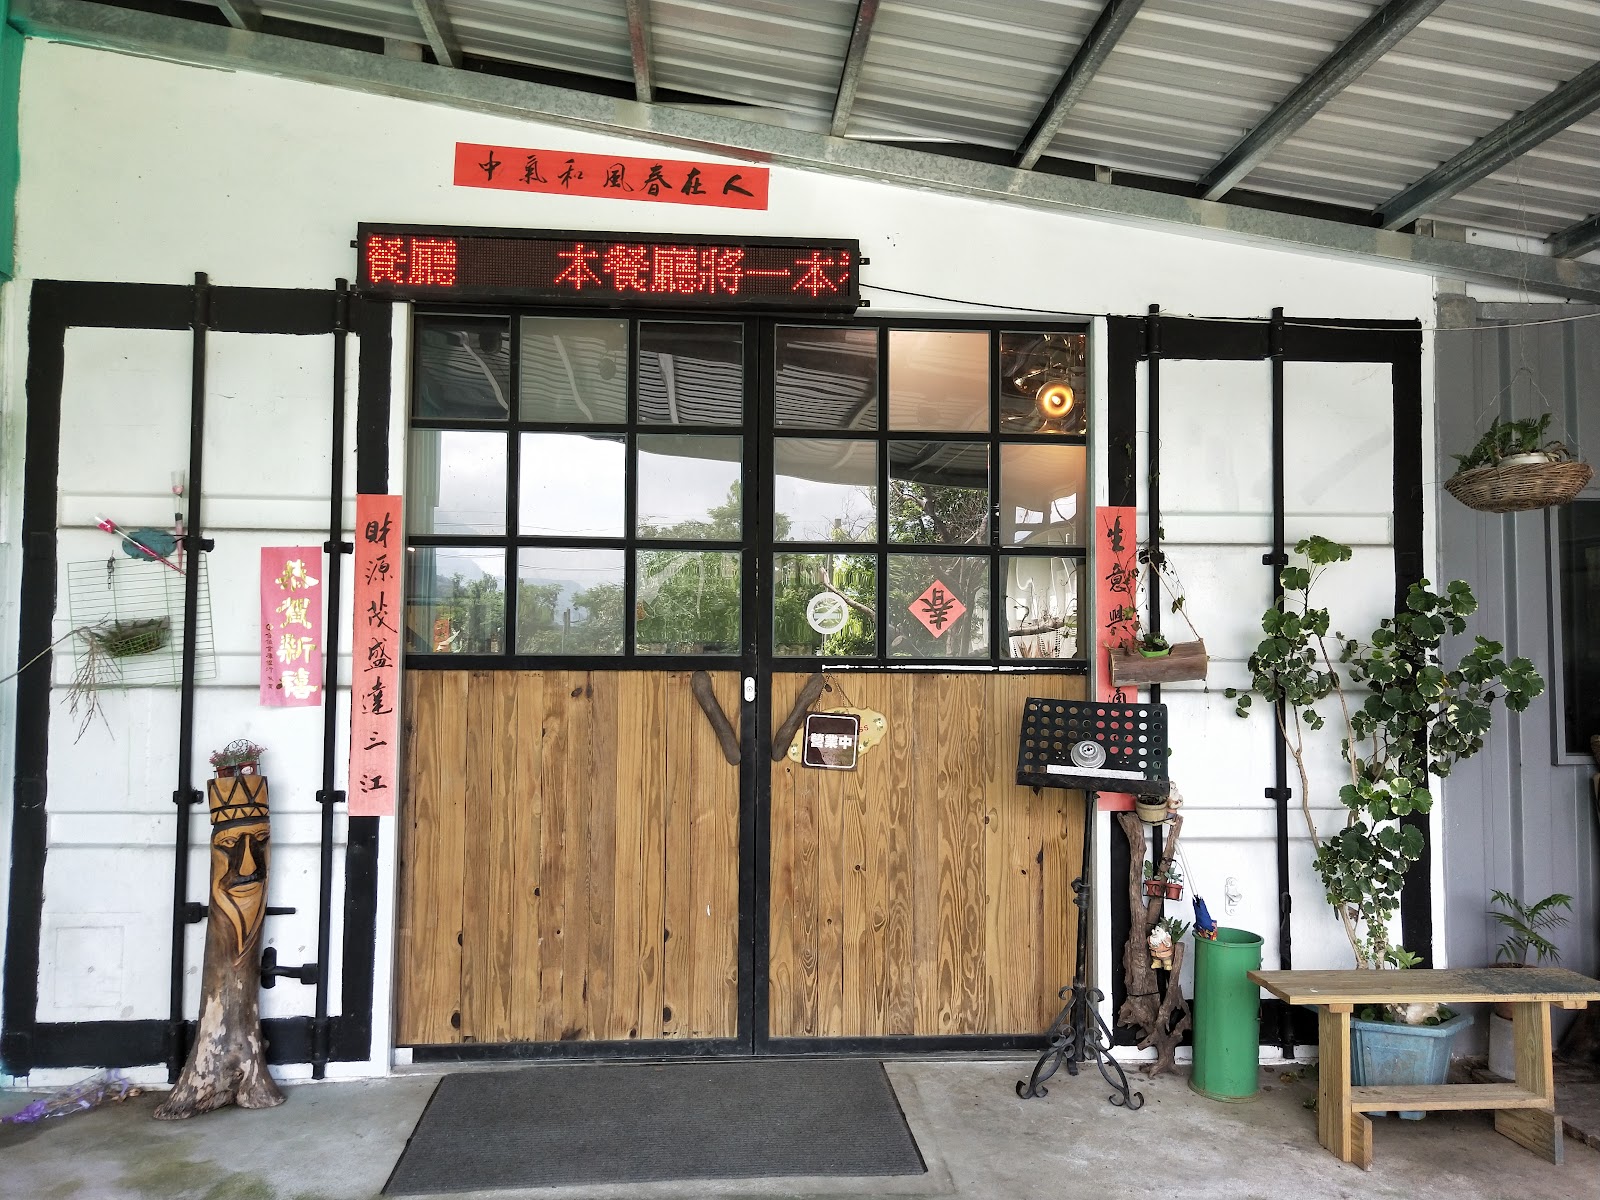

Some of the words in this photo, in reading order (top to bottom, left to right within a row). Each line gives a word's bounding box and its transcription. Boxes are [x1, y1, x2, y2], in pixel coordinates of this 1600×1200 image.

[275, 559, 319, 700] 恭賀新禧
[919, 588, 956, 630] 春
[810, 733, 853, 750] 營業中
